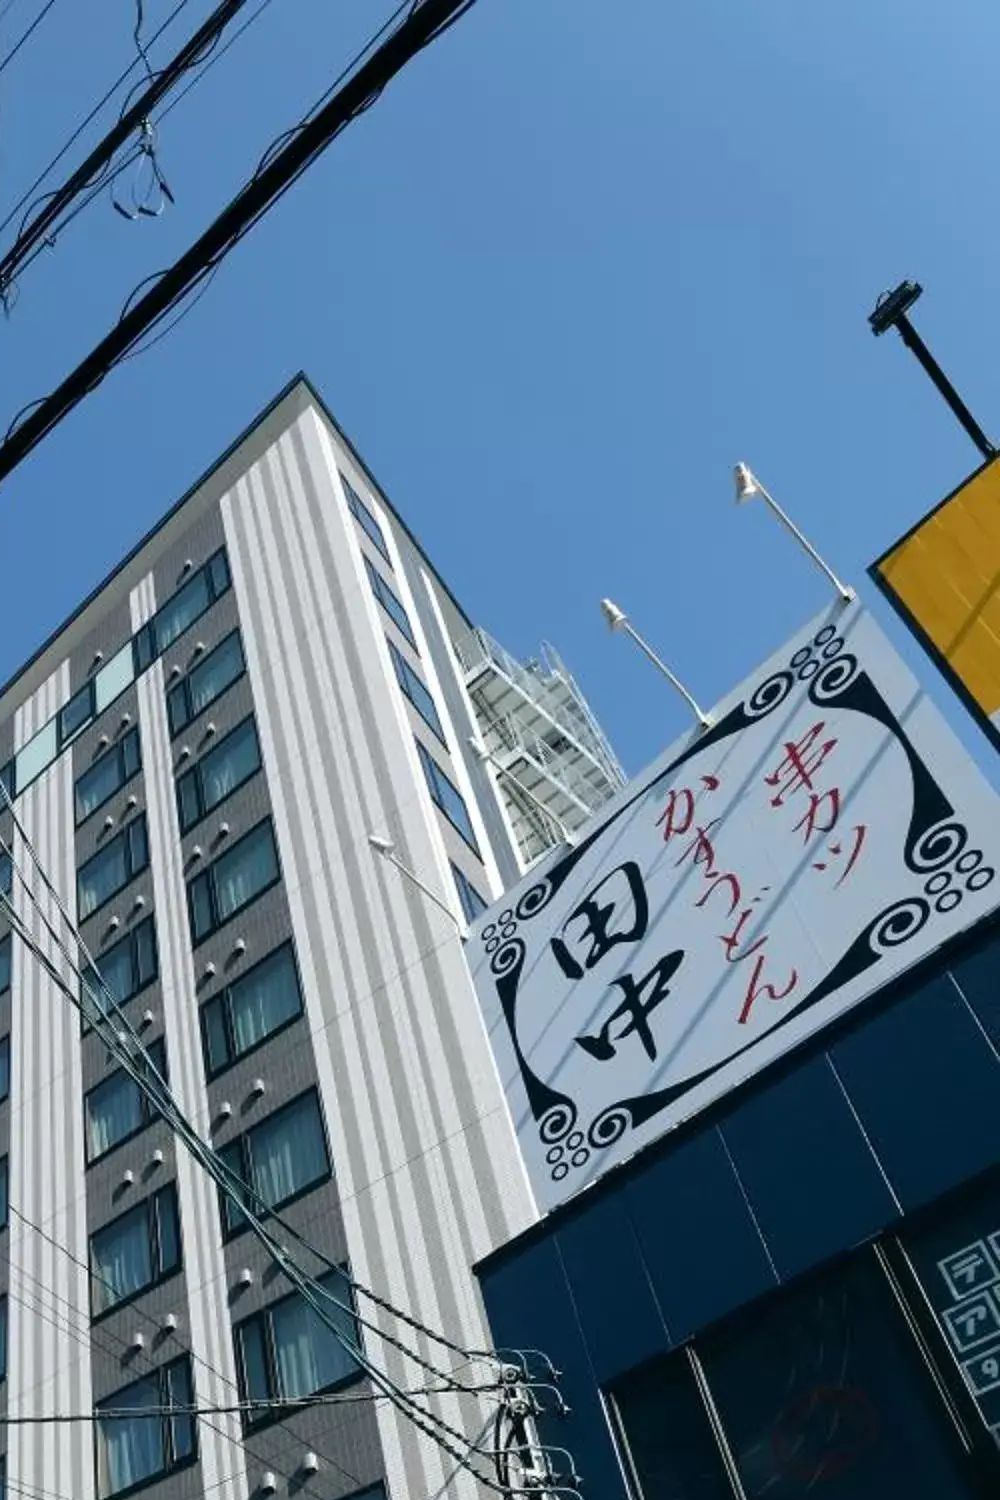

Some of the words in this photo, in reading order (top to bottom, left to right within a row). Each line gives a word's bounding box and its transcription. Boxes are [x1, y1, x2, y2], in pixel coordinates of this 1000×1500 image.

[654, 774, 797, 1025] かすうどん
[763, 720, 867, 890] 串カツ
[550, 859, 685, 1062] 田中
